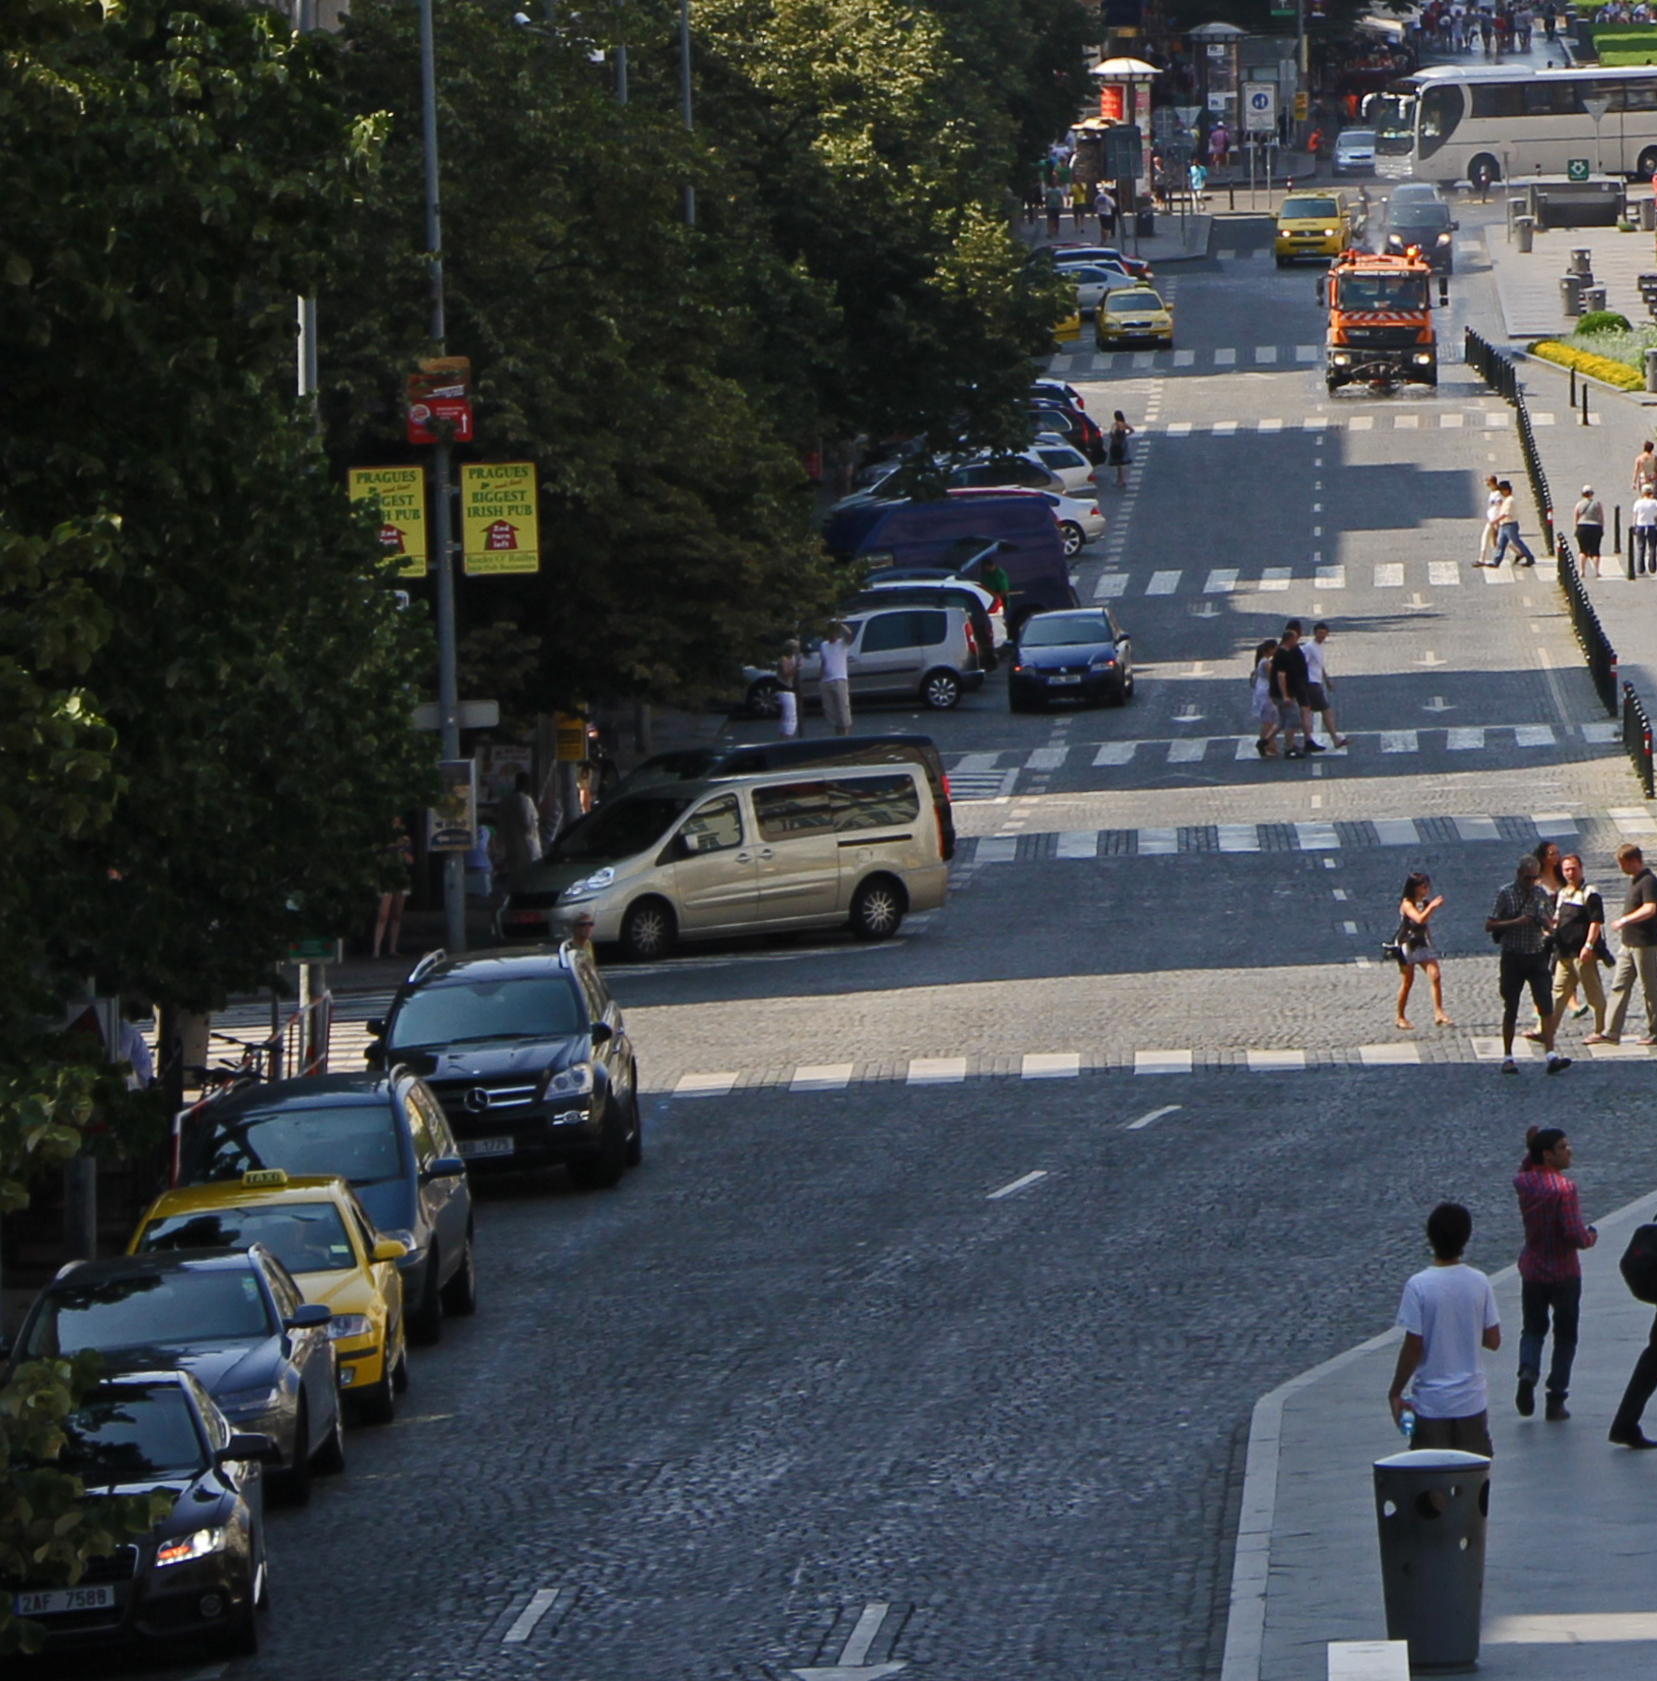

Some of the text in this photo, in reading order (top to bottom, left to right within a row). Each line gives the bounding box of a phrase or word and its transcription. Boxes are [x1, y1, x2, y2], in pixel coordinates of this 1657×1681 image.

[355, 470, 417, 484] PRAGUES
[468, 466, 529, 480] PRAGUES
[472, 490, 527, 504] BIGGEST
[395, 509, 421, 521] PUB
[467, 504, 533, 518] IRISH PUB
[493, 524, 510, 533] 2nd
[492, 532, 511, 541] turn
[493, 540, 509, 548] left
[247, 1172, 279, 1183] TAXI
